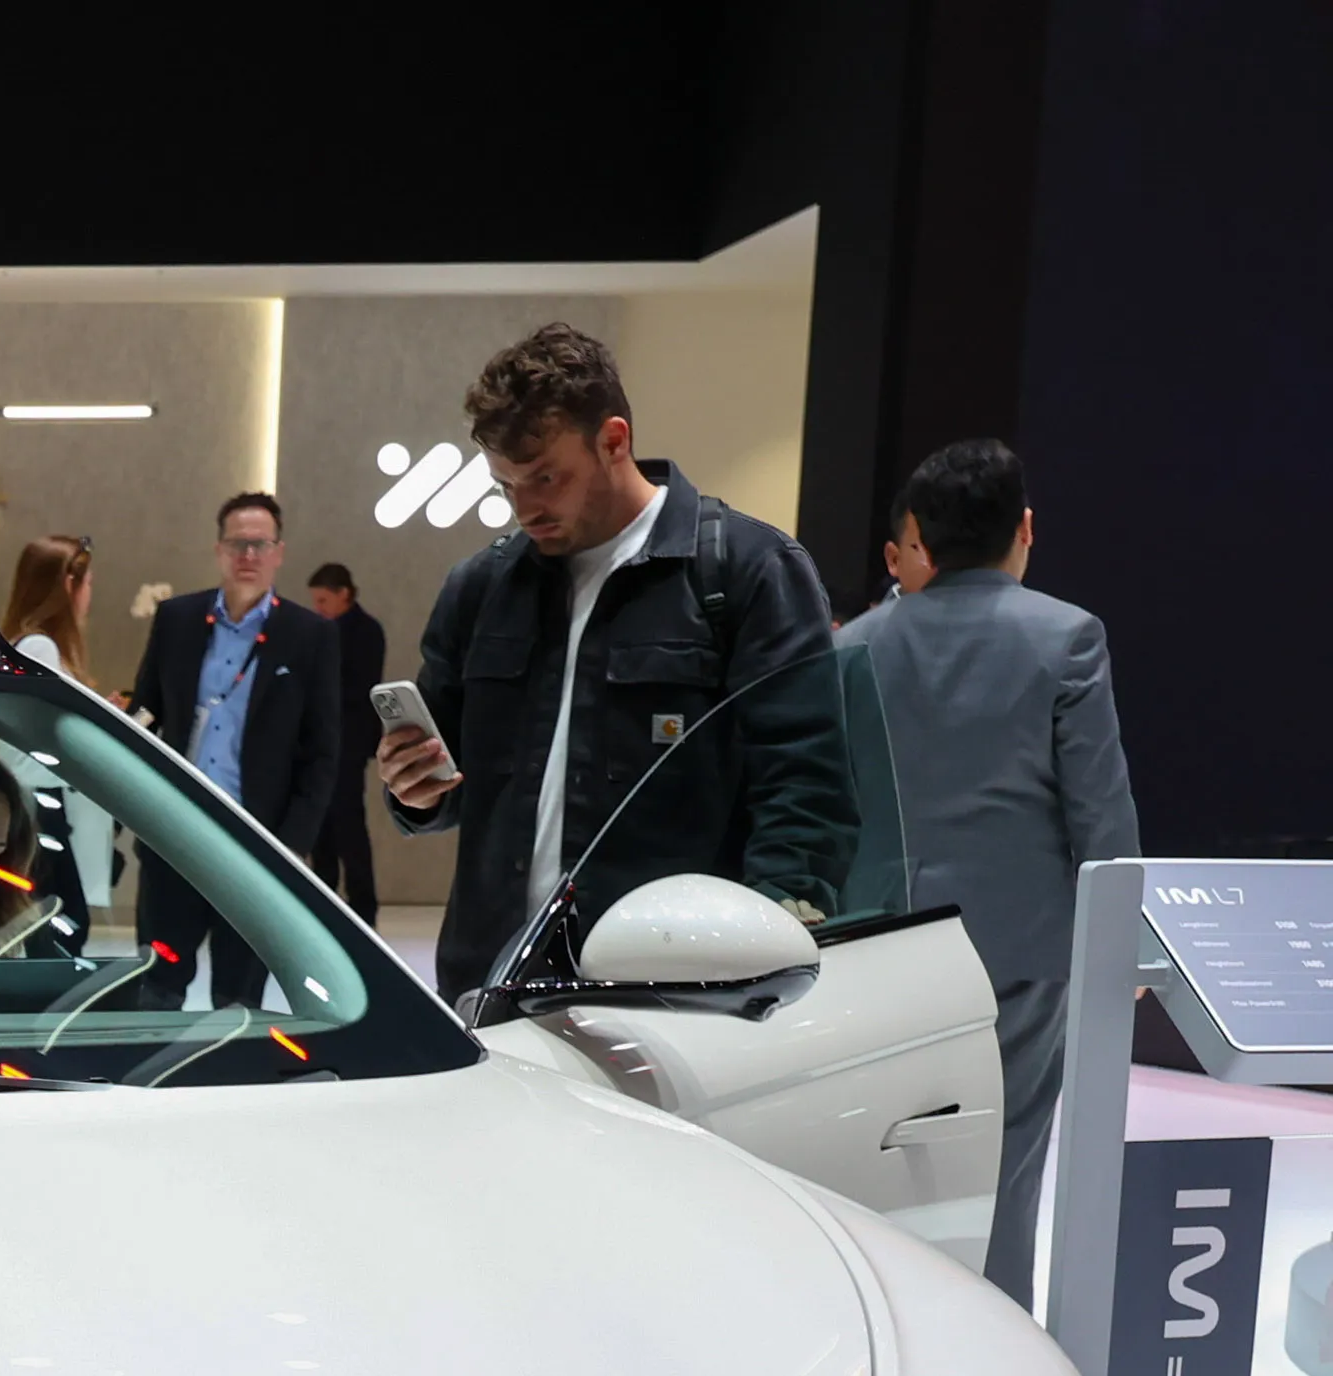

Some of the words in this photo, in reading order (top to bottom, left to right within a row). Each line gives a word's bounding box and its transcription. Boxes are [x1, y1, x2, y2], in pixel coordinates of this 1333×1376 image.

[1155, 887, 1212, 905] IM
[1211, 887, 1244, 905] L7
[1163, 1188, 1231, 1338] IM
